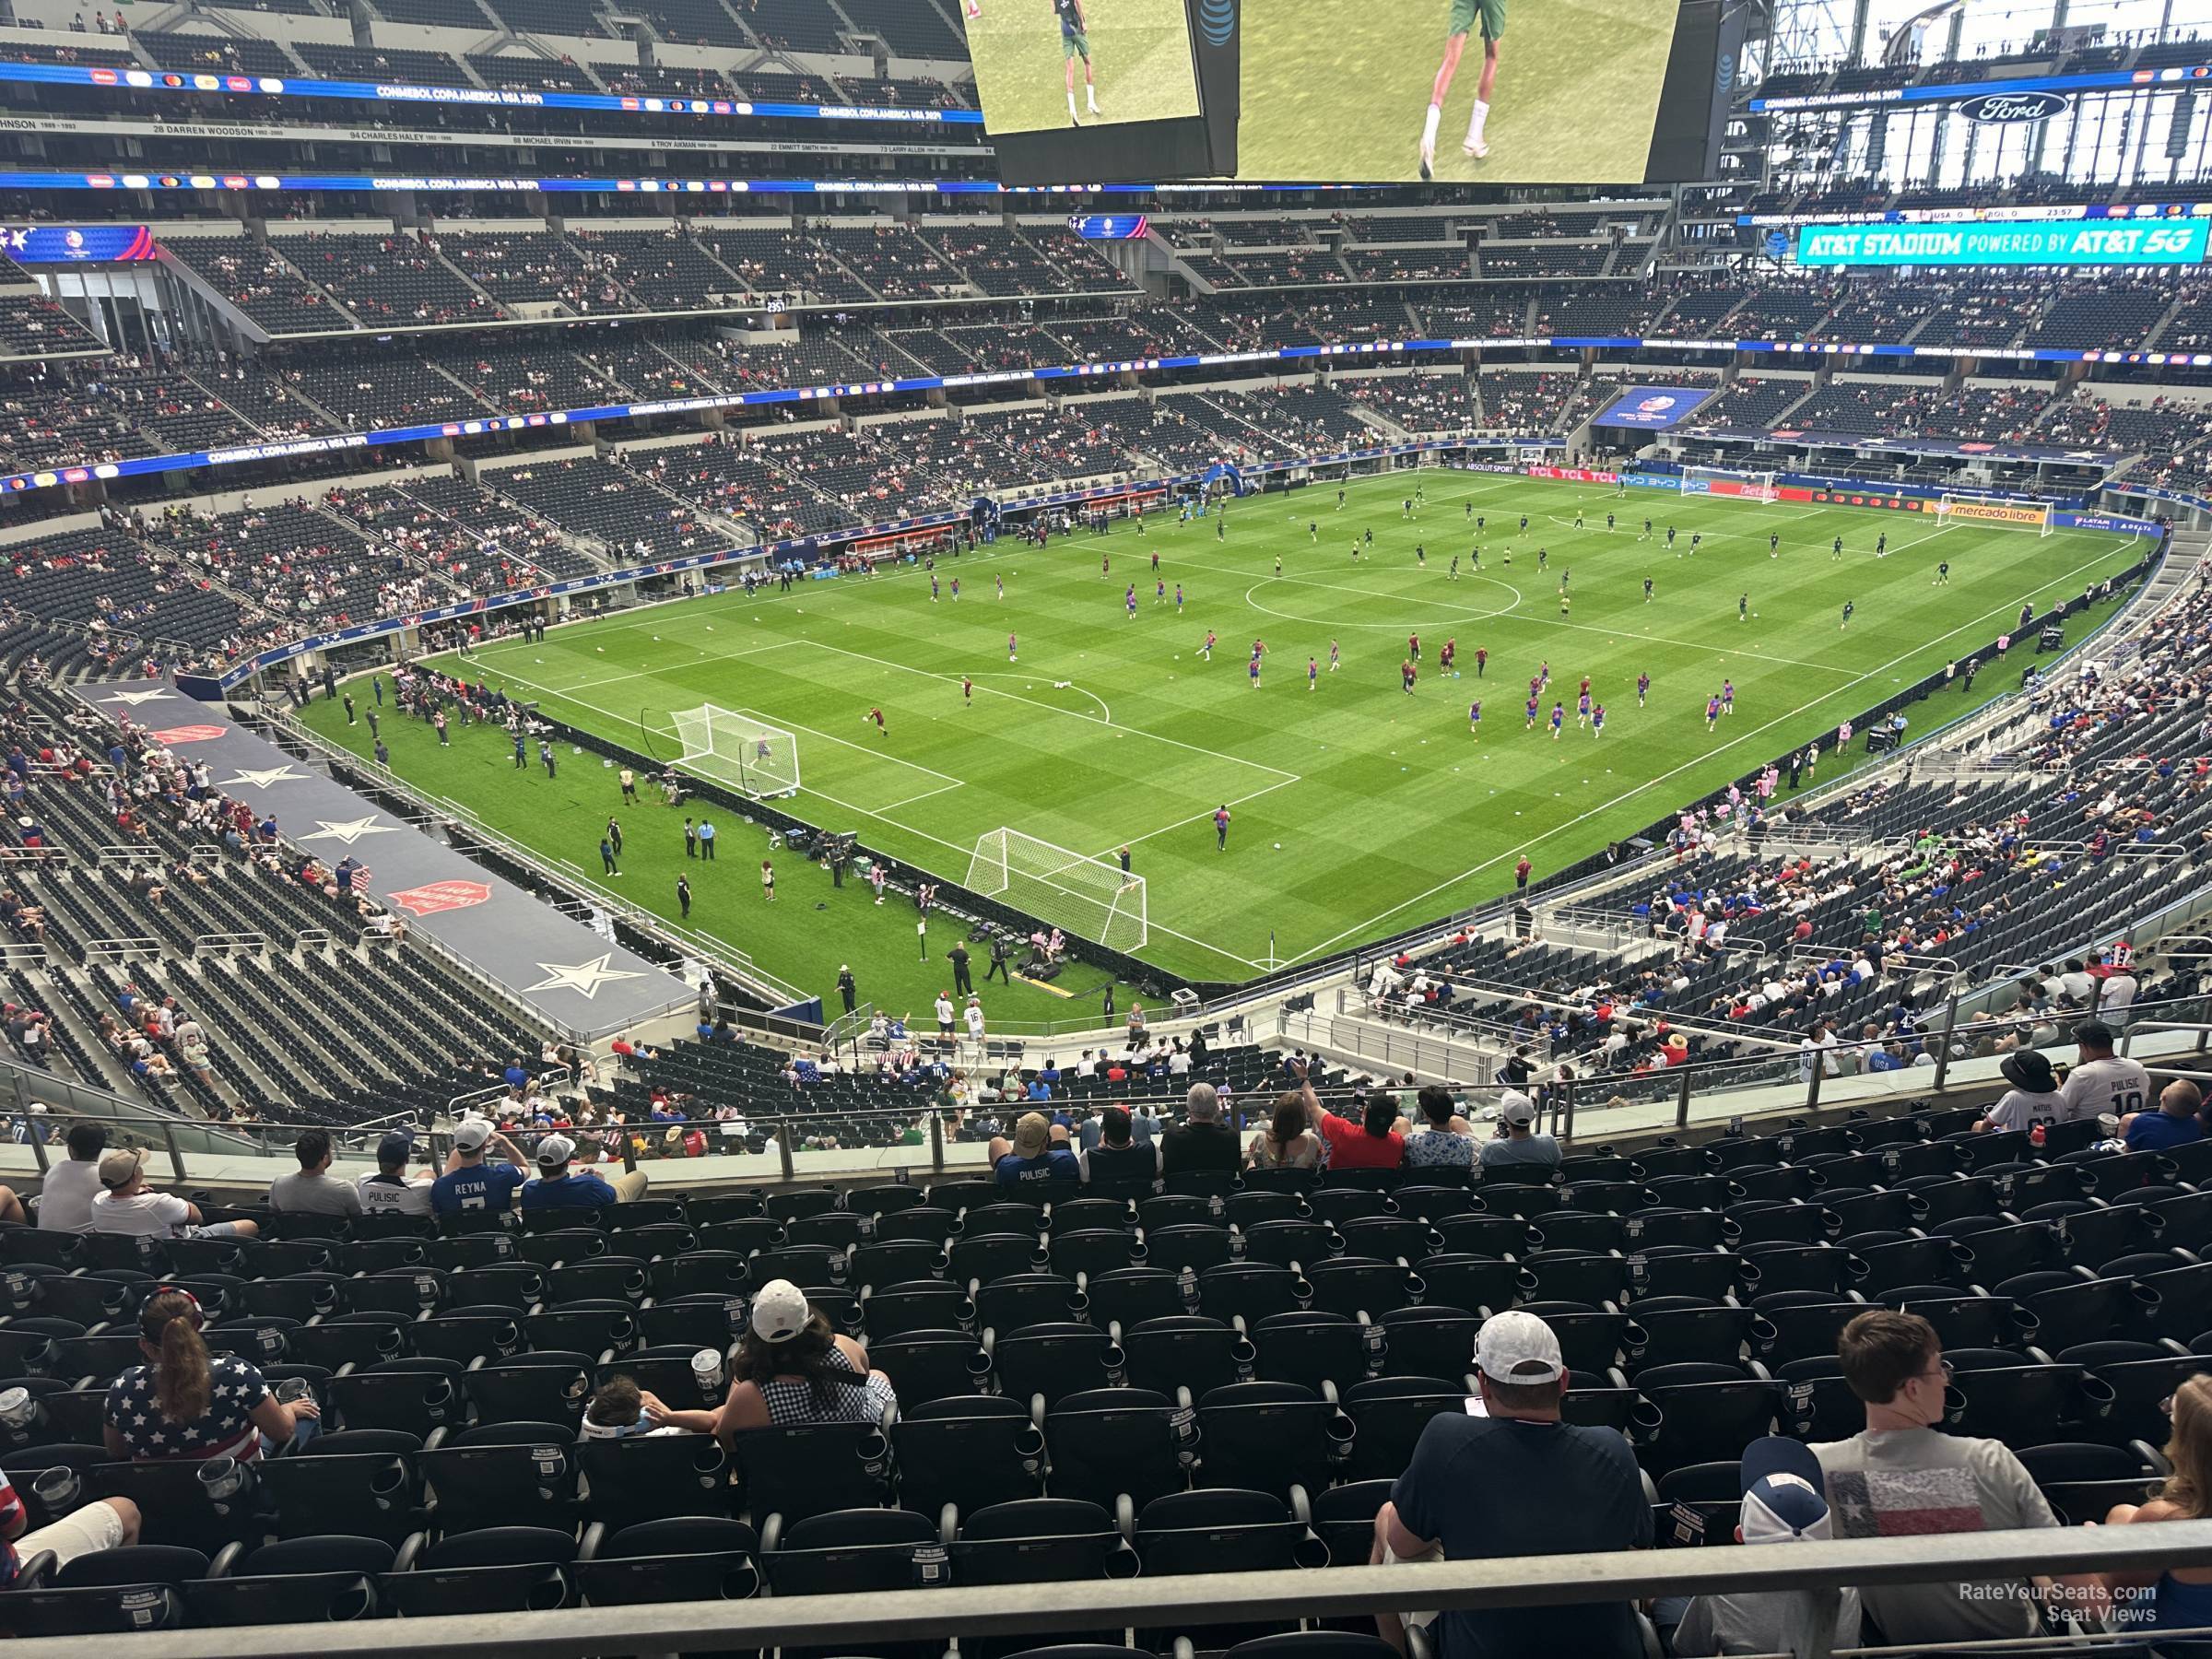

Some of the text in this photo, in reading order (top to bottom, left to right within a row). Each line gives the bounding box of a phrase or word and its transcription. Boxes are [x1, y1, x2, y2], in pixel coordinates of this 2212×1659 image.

[376, 86, 432, 99] CONMEBOL
[433, 88, 459, 100] COPA
[457, 89, 500, 102] AMERICA
[501, 91, 520, 103] USA
[1764, 99, 1807, 109] CONMEBOL
[1807, 96, 1829, 107] COPA
[1827, 94, 1865, 106] AMERICA
[1865, 92, 1881, 102] USA
[819, 107, 859, 118] CONMEBOL
[860, 109, 877, 118] COPA
[877, 110, 911, 120] AMERICA
[912, 111, 924, 120] USA
[1979, 96, 2045, 120] Ford
[153, 125, 164, 134] 28
[167, 126, 205, 135] DARREN
[208, 127, 253, 135] WOODSON
[361, 132, 397, 140] CHARLES
[1806, 229, 2194, 255] AT&T STADIUM POWERED BY AT&T 5G
[207, 449, 260, 464] CONMEBOL
[262, 446, 287, 457] COPA
[286, 441, 327, 454] AMERICA
[328, 439, 345, 449] USA
[1466, 463, 1513, 474] ABSOLUT SPORT
[1529, 466, 1617, 483] TCL TCL TCL
[1648, 477, 1677, 487] BYD
[1680, 479, 1708, 490] BYD
[1740, 485, 1780, 498] Betano
[1955, 505, 2036, 522] mercado libre
[2083, 517, 2110, 525] LATAM
[971, 1013, 979, 1022] 16
[1874, 1059, 1889, 1069] USA
[932, 1067, 943, 1077] 10
[2111, 1077, 2138, 1091] PULISIC
[2111, 1091, 2143, 1114] 10
[1019, 1168, 1050, 1180] PULISIC
[455, 1182, 487, 1195] REYNA
[369, 1192, 400, 1202] PULISIC
